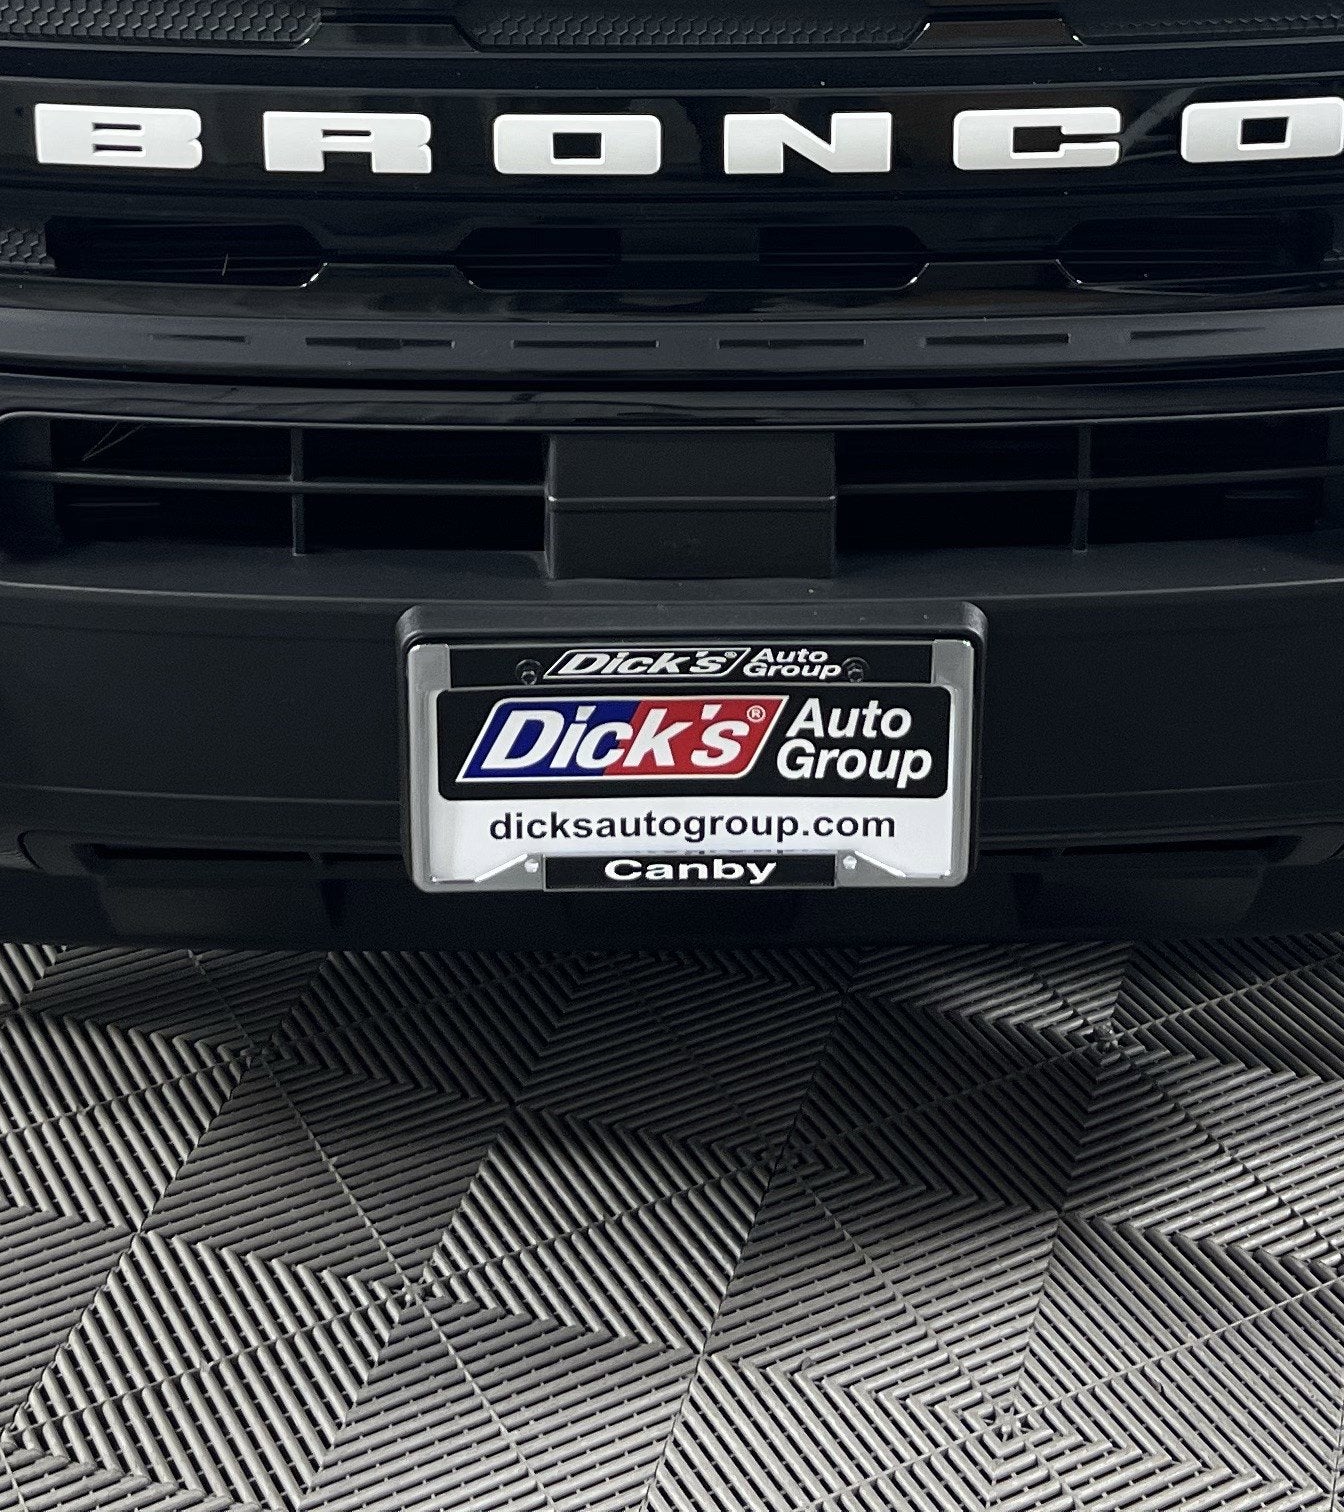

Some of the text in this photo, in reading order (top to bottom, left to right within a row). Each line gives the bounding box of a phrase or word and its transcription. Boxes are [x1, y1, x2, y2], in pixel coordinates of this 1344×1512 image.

[558, 649, 727, 676] Dick's
[743, 661, 842, 680] Group
[753, 647, 829, 664] Auto
[786, 697, 912, 739] Auto
[479, 704, 751, 771] Dick's
[776, 739, 933, 789] Group
[489, 811, 896, 843] dicksautogroup.com
[604, 857, 777, 885] Canby
